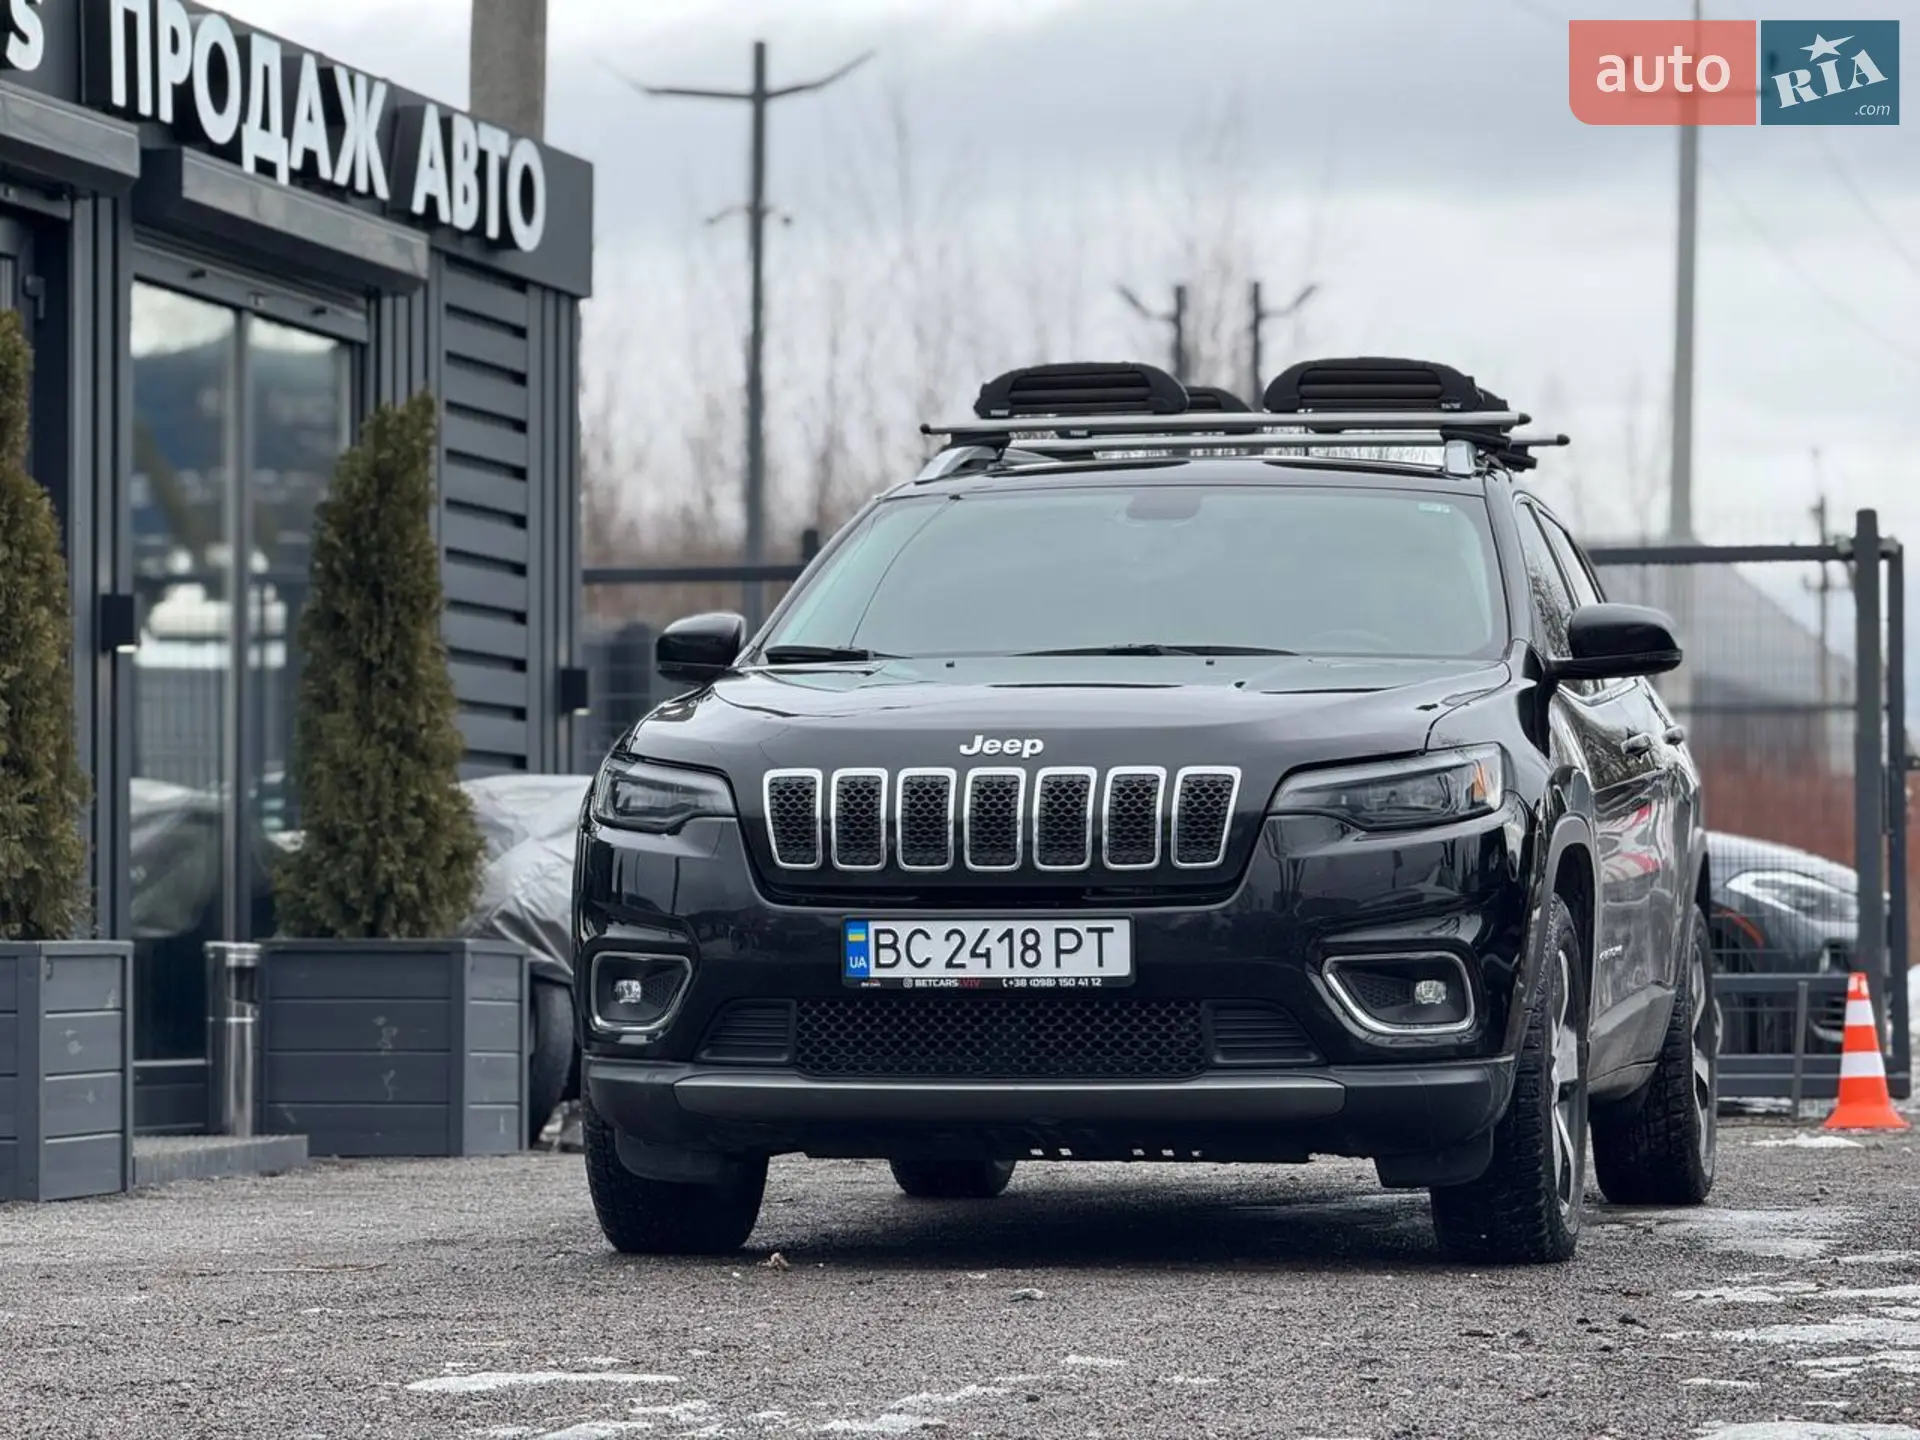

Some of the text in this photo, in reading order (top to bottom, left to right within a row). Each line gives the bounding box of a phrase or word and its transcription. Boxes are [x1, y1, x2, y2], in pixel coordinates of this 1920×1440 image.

[110, 0, 546, 252] ПРОДАЖ АВТО
[959, 734, 1044, 759] Jeep
[873, 926, 1115, 969] BC 2418 PT
[849, 957, 867, 969] UA
[1058, 978, 1076, 988] 150
[1078, 978, 1089, 988] 41
[1091, 978, 1103, 988] 12
